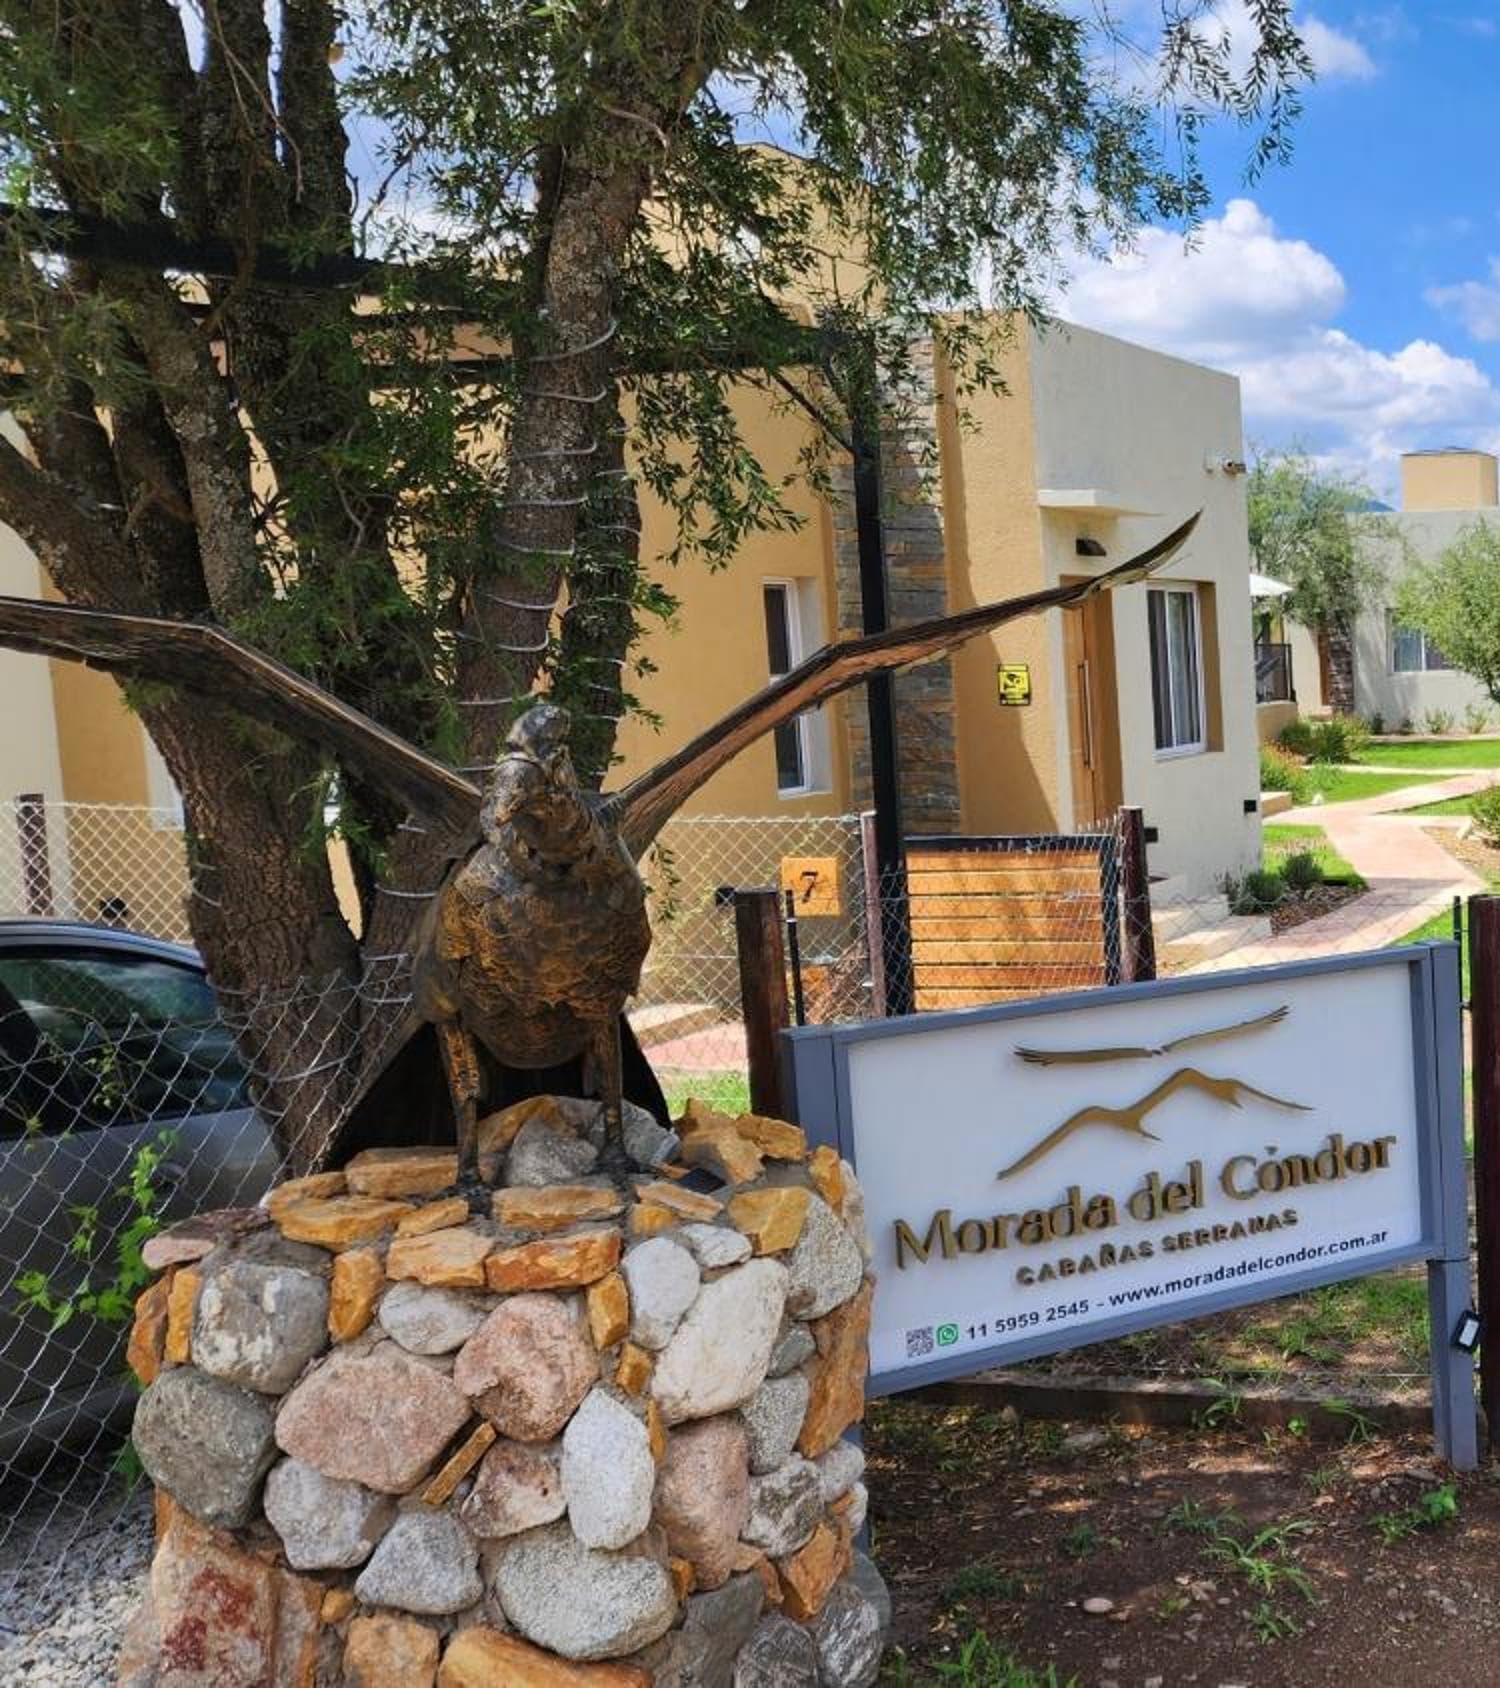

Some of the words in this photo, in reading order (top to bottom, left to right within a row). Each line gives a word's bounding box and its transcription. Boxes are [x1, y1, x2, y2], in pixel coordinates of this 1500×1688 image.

[800, 871, 819, 904] 7
[893, 1185, 1119, 1271] Morada
[1127, 1160, 1205, 1222] del
[1219, 1133, 1397, 1200] Cóndor
[1016, 1240, 1154, 1285] CABAÑAS
[1161, 1209, 1299, 1252] SERRANAS
[967, 1324, 988, 1339] 11
[995, 1312, 1039, 1334] 5959
[1046, 1299, 1089, 1322] 2545
[1108, 1229, 1389, 1307] www.moradadelcondor.com.ar
